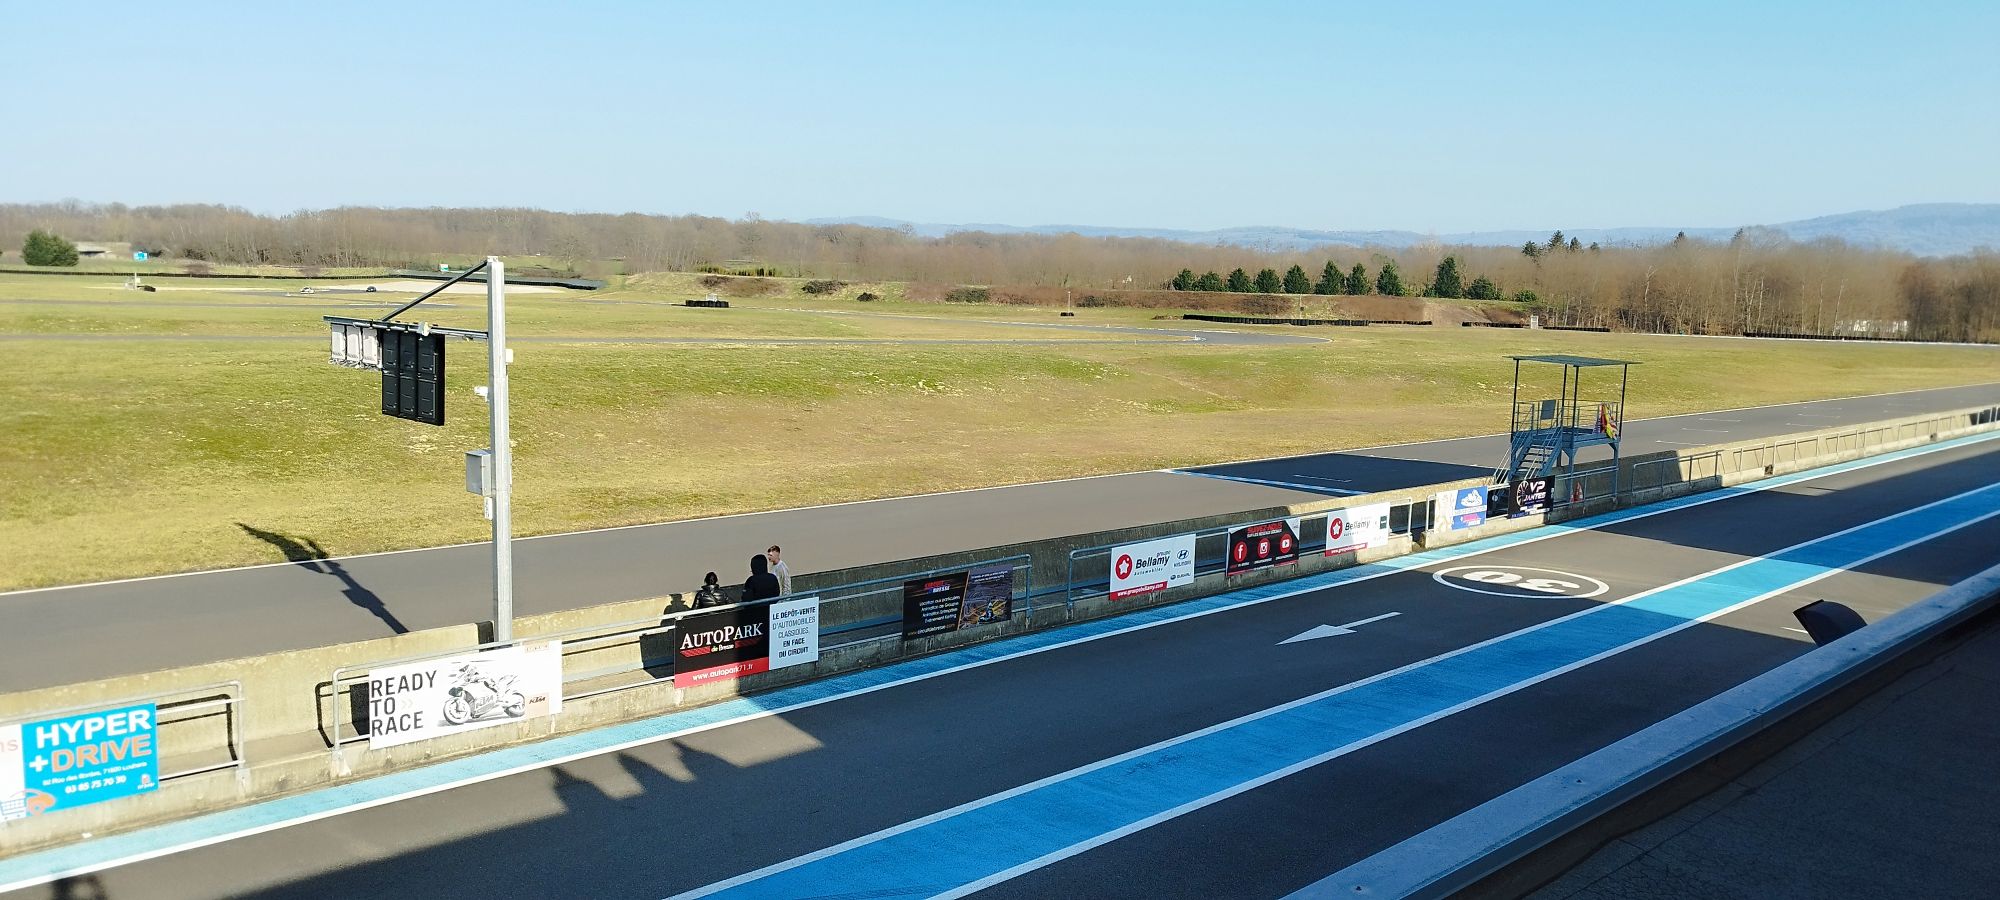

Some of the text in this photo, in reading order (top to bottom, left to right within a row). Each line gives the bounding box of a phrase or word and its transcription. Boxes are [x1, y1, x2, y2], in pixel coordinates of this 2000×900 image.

[1530, 480, 1546, 493] VP
[1135, 554, 1170, 570] Bellamy
[772, 611, 780, 620] LE
[777, 626, 809, 639] CLASSIQUES
[718, 643, 735, 652] Bresse
[782, 637, 805, 648] EN FACE
[778, 646, 809, 658] DU CIRCUIT
[692, 663, 753, 681] www.autopark71.fr
[371, 669, 438, 698] READY
[370, 697, 396, 717] TO
[36, 709, 152, 749] HYPER
[371, 710, 424, 737] RACE
[64, 784, 77, 794] 03
[91, 779, 102, 789] 75
[103, 777, 115, 787] 70
[115, 774, 127, 784] 30
